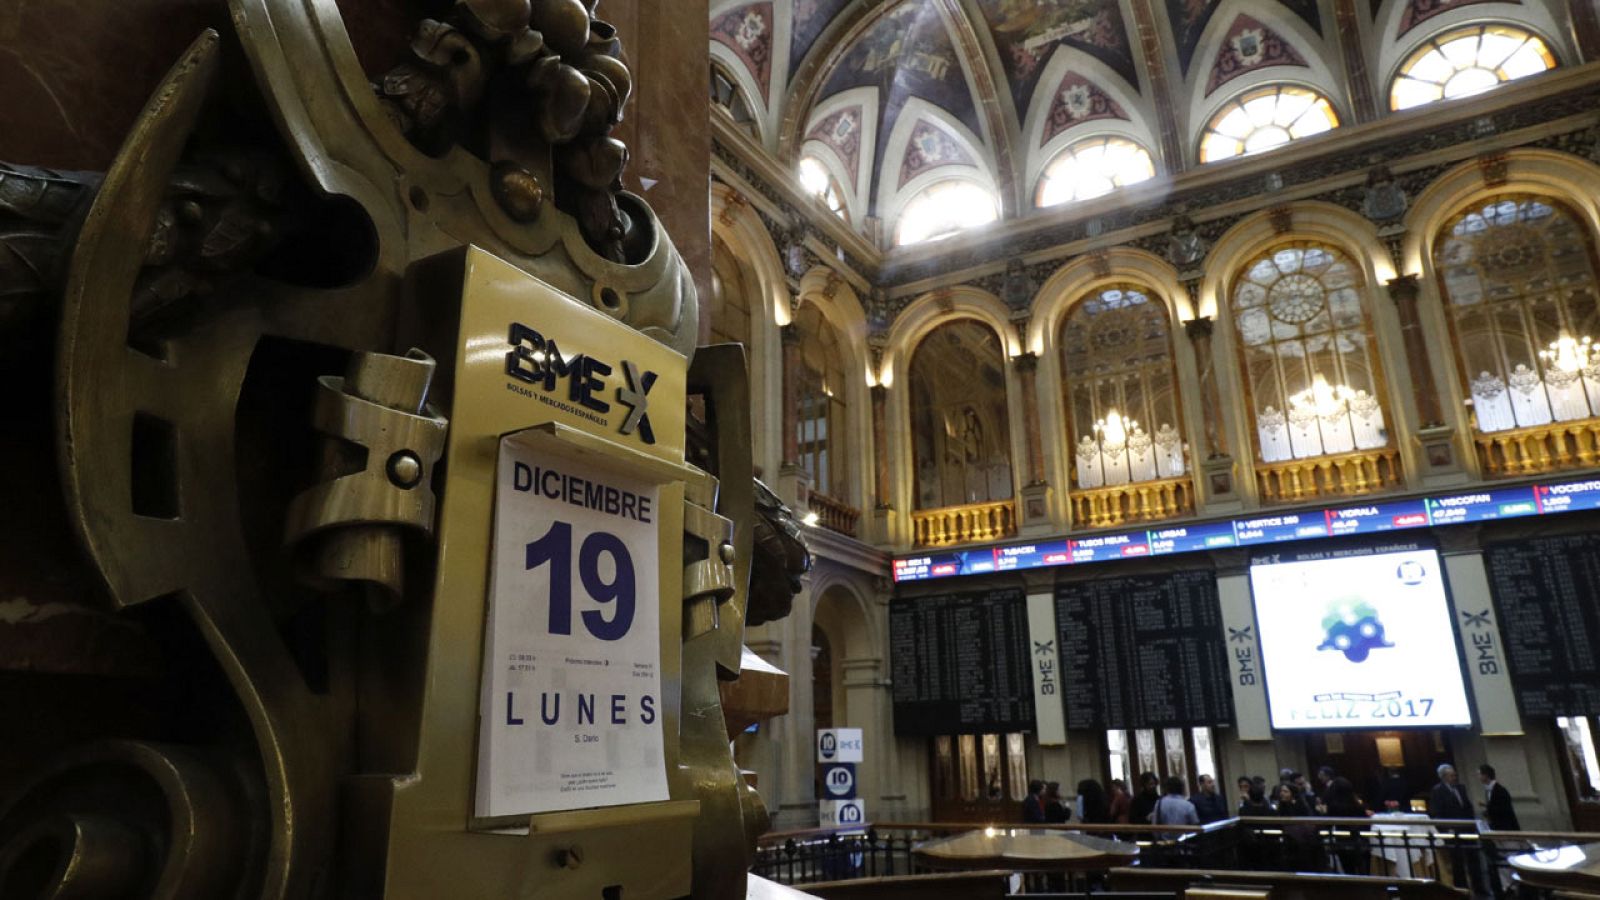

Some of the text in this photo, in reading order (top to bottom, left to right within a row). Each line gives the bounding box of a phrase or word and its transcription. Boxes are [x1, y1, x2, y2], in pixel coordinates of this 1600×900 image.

[539, 394, 574, 414] MERCADOS
[514, 461, 651, 523] DICIEMBRE
[526, 520, 636, 641] 19
[506, 691, 656, 726] LUNES
[1371, 698, 1435, 719] 2017
[823, 734, 835, 750] 10
[832, 771, 848, 786] 10
[843, 806, 858, 821] 10
